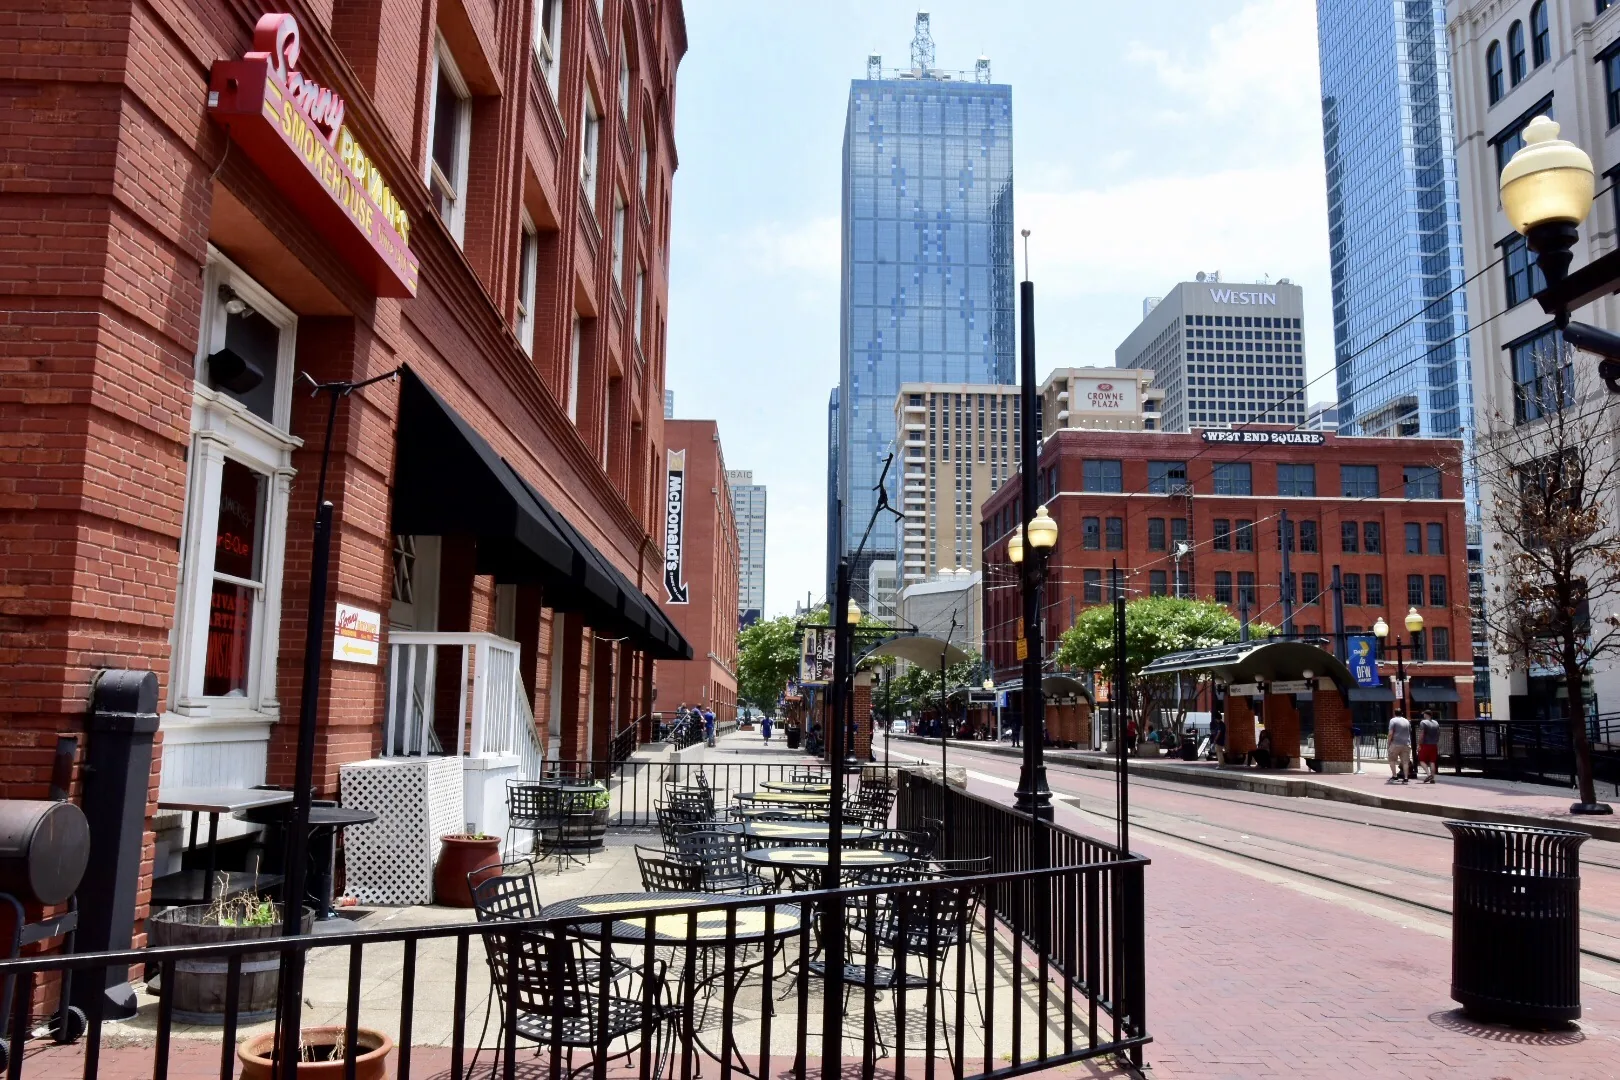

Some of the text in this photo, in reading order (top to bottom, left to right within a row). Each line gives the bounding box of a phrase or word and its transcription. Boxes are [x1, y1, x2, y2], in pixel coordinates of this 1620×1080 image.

[279, 100, 375, 238] SMOKEHOUSE
[1087, 392, 1124, 400] CROWNE
[1091, 400, 1119, 408] PLAZA
[1206, 431, 1319, 444] WEST END SQUARE
[666, 475, 682, 571] McDonald's
[1356, 665, 1372, 679] DFW
